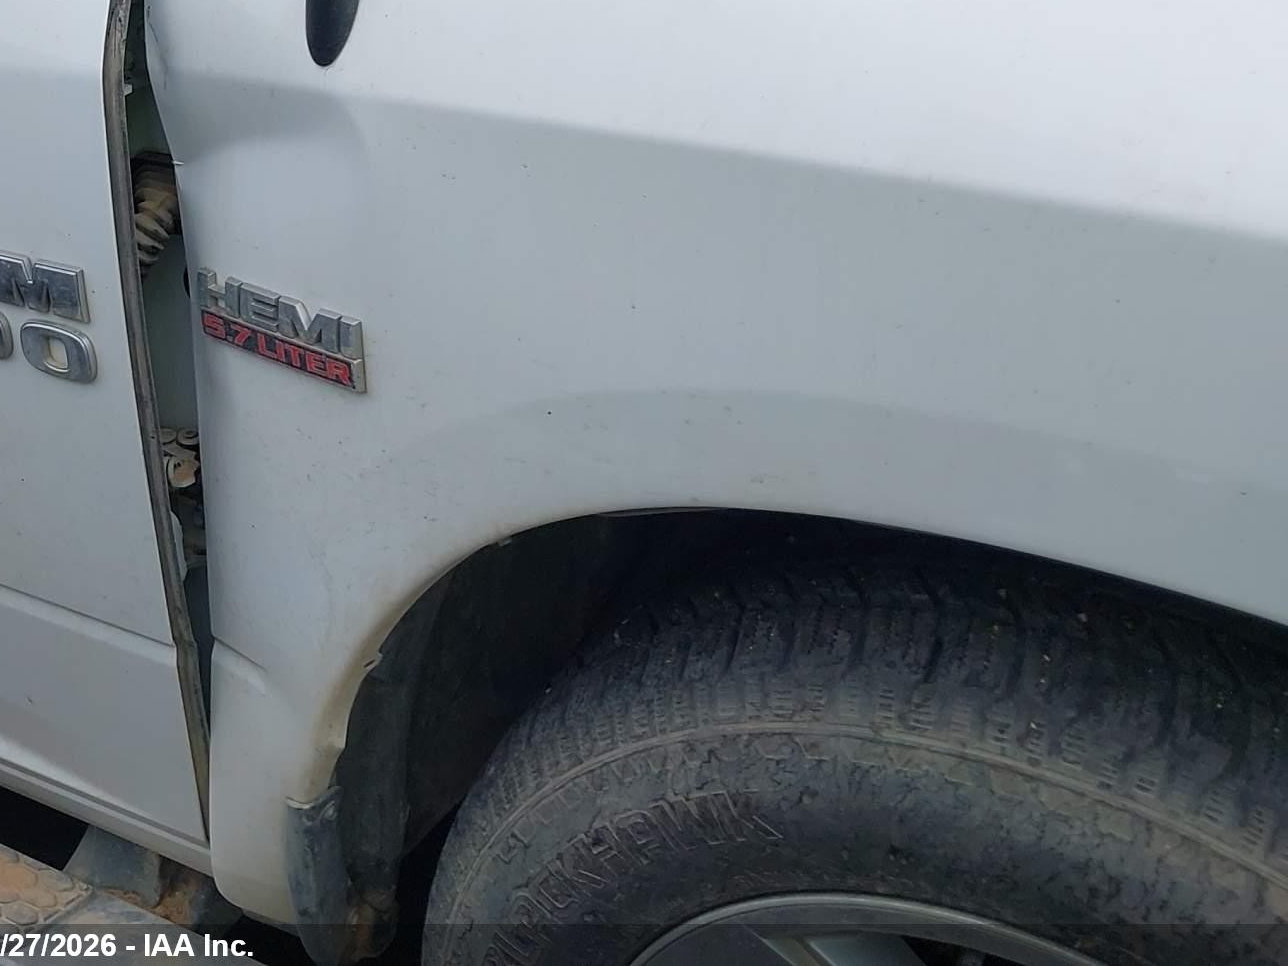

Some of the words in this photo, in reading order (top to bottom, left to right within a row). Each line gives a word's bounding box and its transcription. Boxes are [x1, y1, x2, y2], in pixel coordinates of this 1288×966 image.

[197, 267, 365, 360] HEMI
[201, 312, 250, 351] 5.7
[255, 329, 355, 387] LITER
